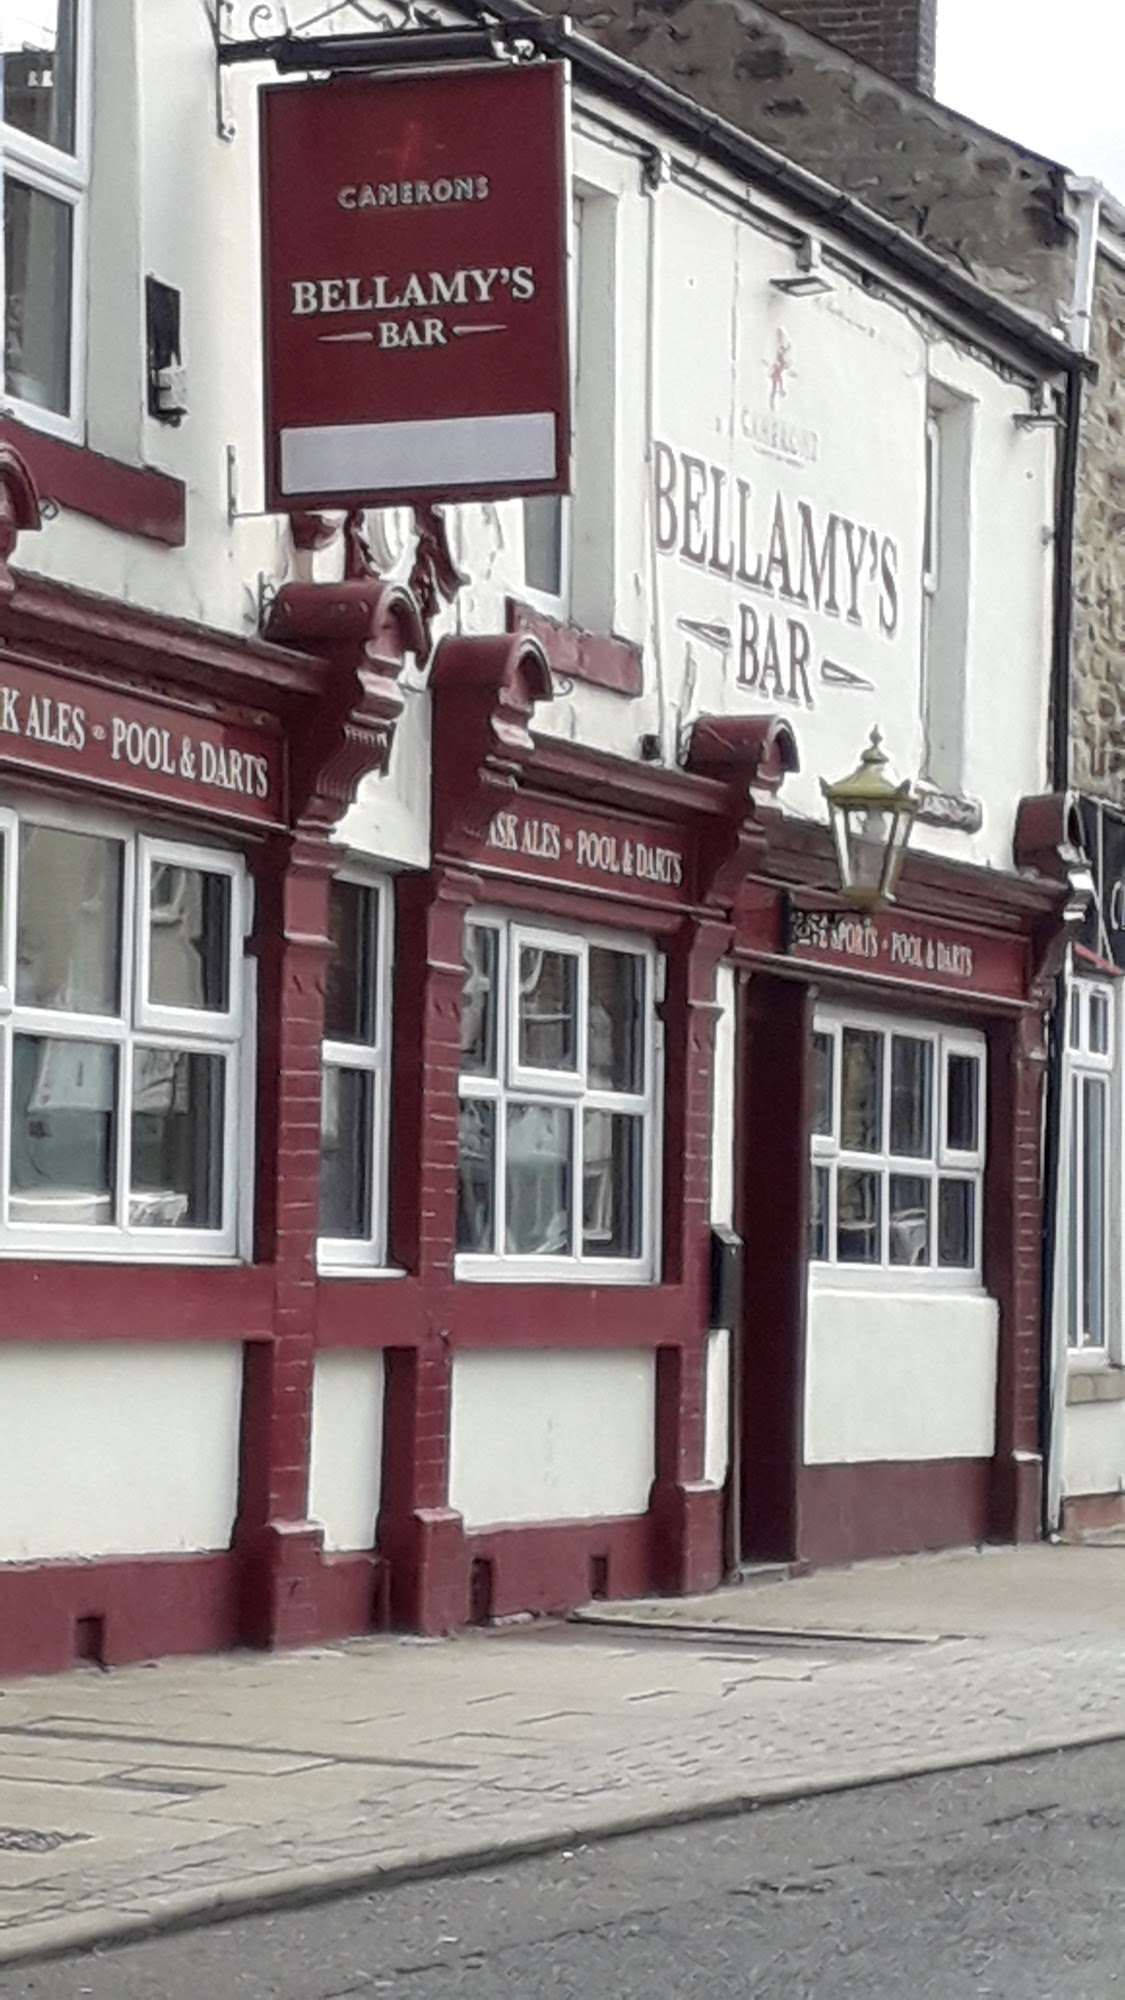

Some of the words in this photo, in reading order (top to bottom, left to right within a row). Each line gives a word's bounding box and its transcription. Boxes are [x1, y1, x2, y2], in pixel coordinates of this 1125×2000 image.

[337, 175, 490, 210] CAMERONS
[290, 265, 536, 316] BELLAMY'S
[377, 317, 448, 349] BAR
[652, 440, 899, 637] BELLAMY'S
[736, 602, 814, 710] BAR
[25, 695, 86, 751] ALES
[110, 716, 176, 775] POOL
[180, 735, 197, 780] &
[200, 740, 269, 799] DARTS
[520, 819, 561, 861] ALES
[576, 828, 621, 873] POOL
[622, 839, 634, 876] &
[635, 843, 683, 885] DARTS
[891, 930, 923, 968] POOL
[937, 940, 974, 977] DARTS
